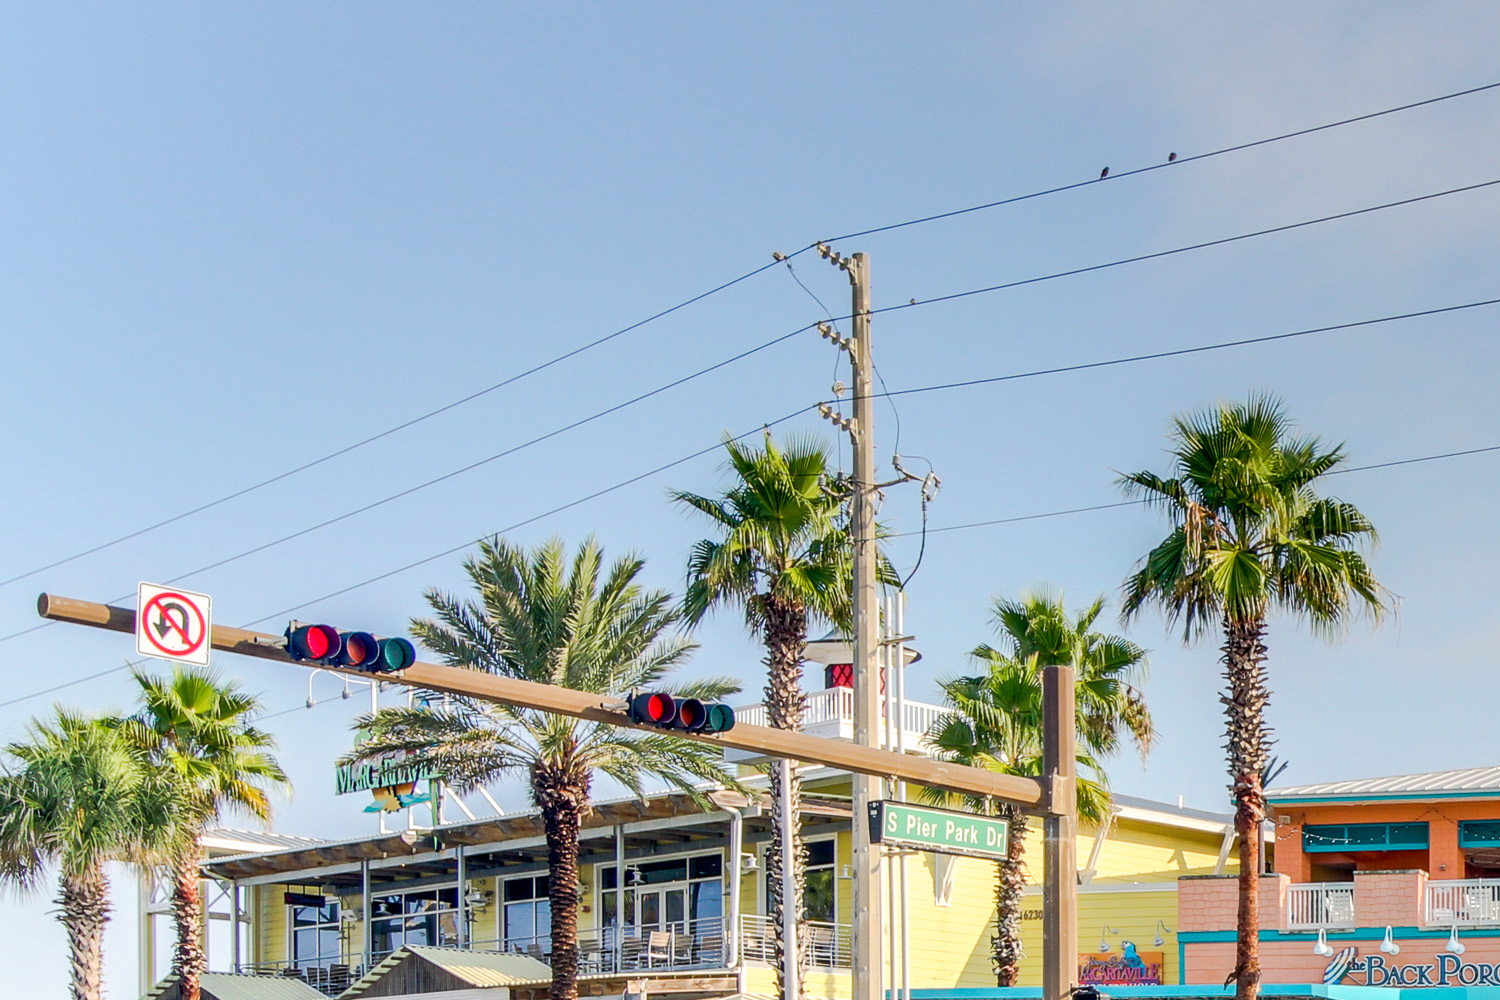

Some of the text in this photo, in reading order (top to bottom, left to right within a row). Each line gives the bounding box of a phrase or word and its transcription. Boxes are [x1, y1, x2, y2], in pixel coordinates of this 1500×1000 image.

[887, 812, 1003, 848] S Pier Park Dr
[1348, 955, 1366, 971] the
[1365, 955, 1435, 986] BACK
